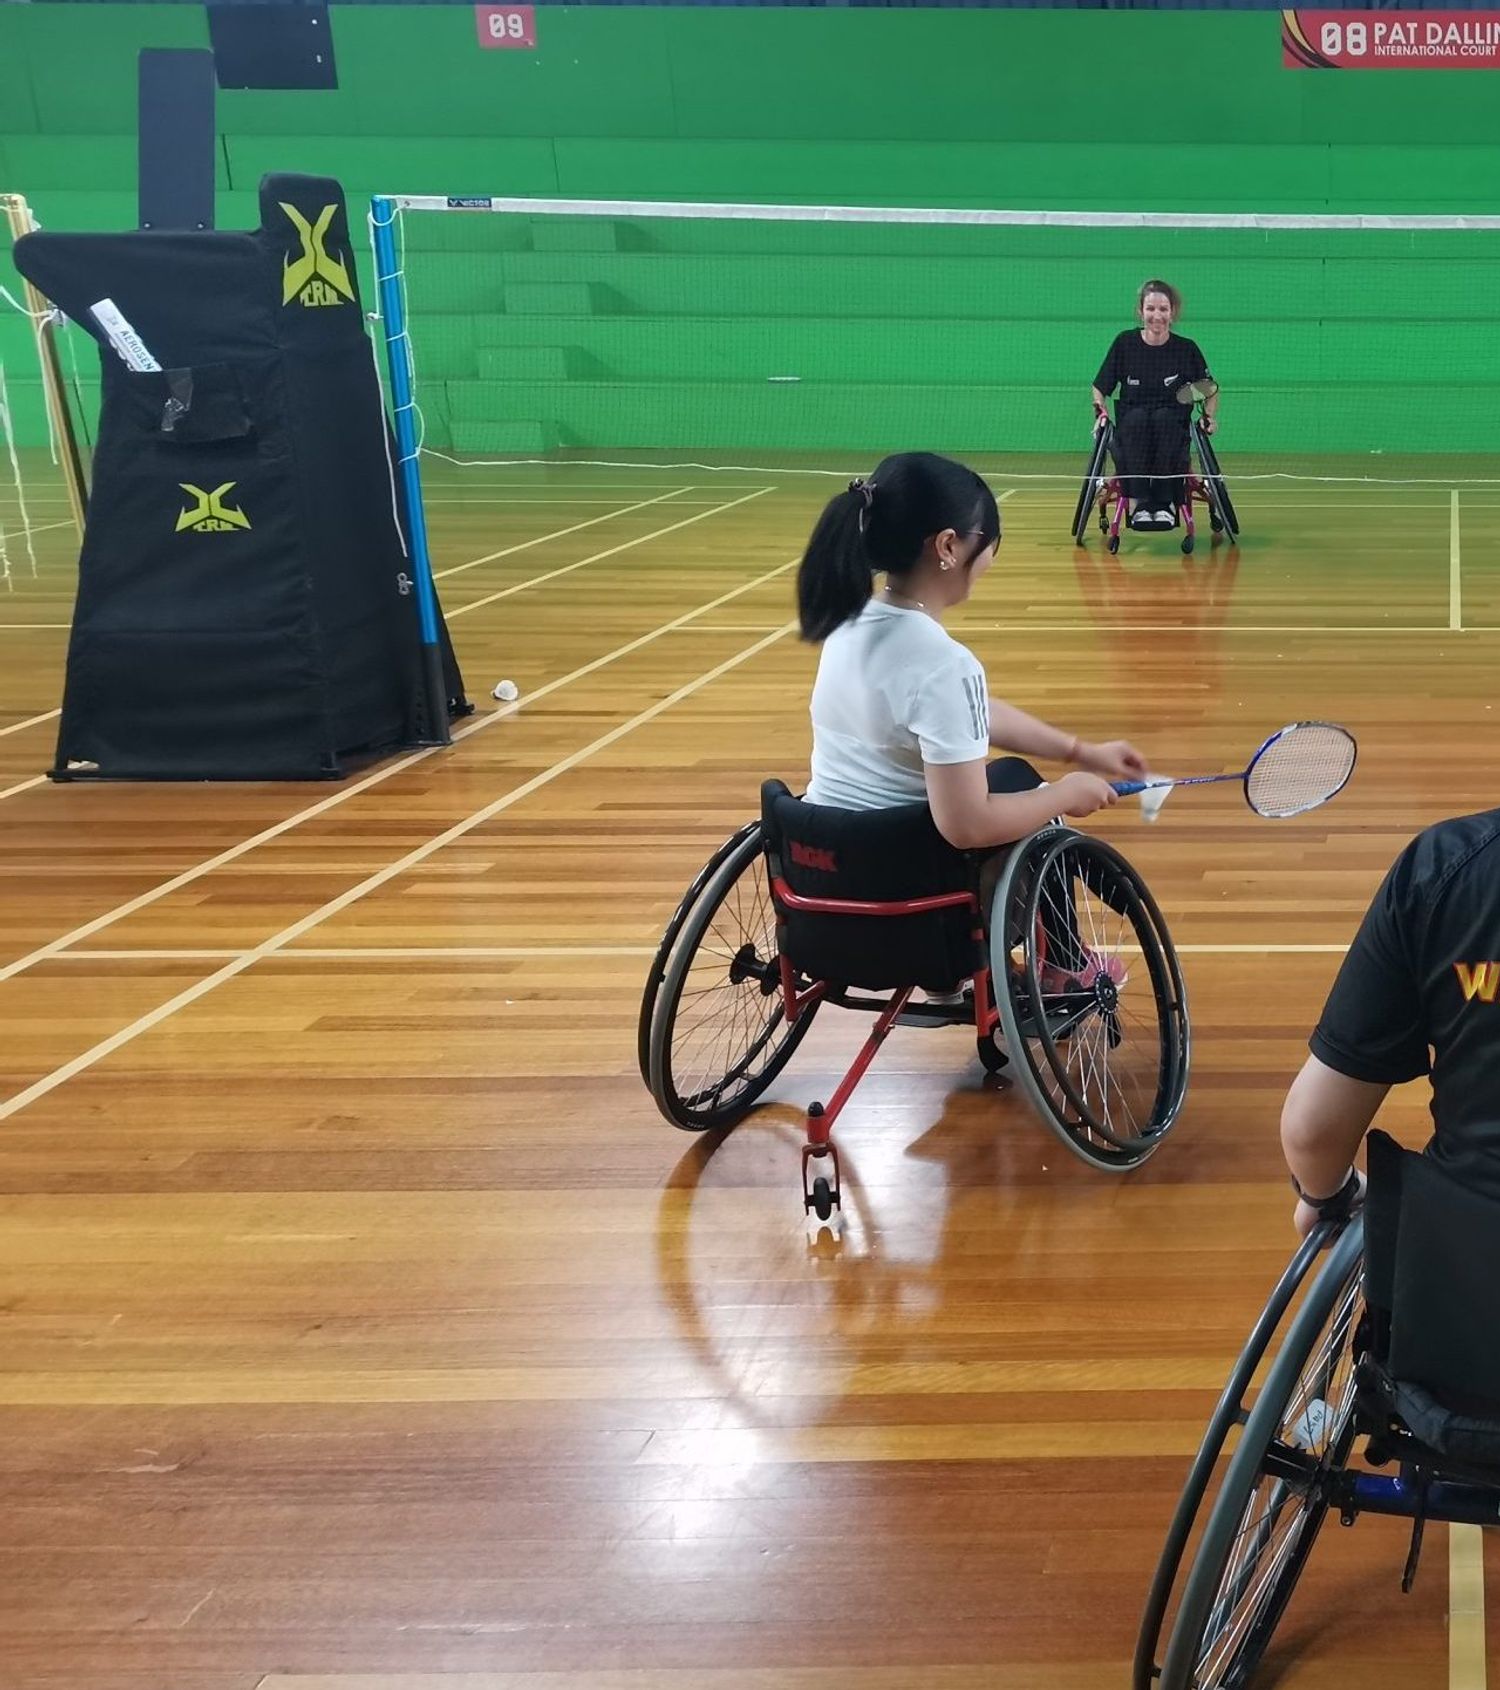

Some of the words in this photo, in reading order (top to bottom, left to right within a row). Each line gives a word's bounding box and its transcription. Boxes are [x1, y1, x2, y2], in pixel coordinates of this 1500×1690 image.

[488, 13, 524, 38] 09
[1374, 22, 1418, 45] PAT
[1321, 22, 1367, 56] 08
[1374, 45, 1458, 56] INTERNATIONAL
[1460, 45, 1497, 56] COURT
